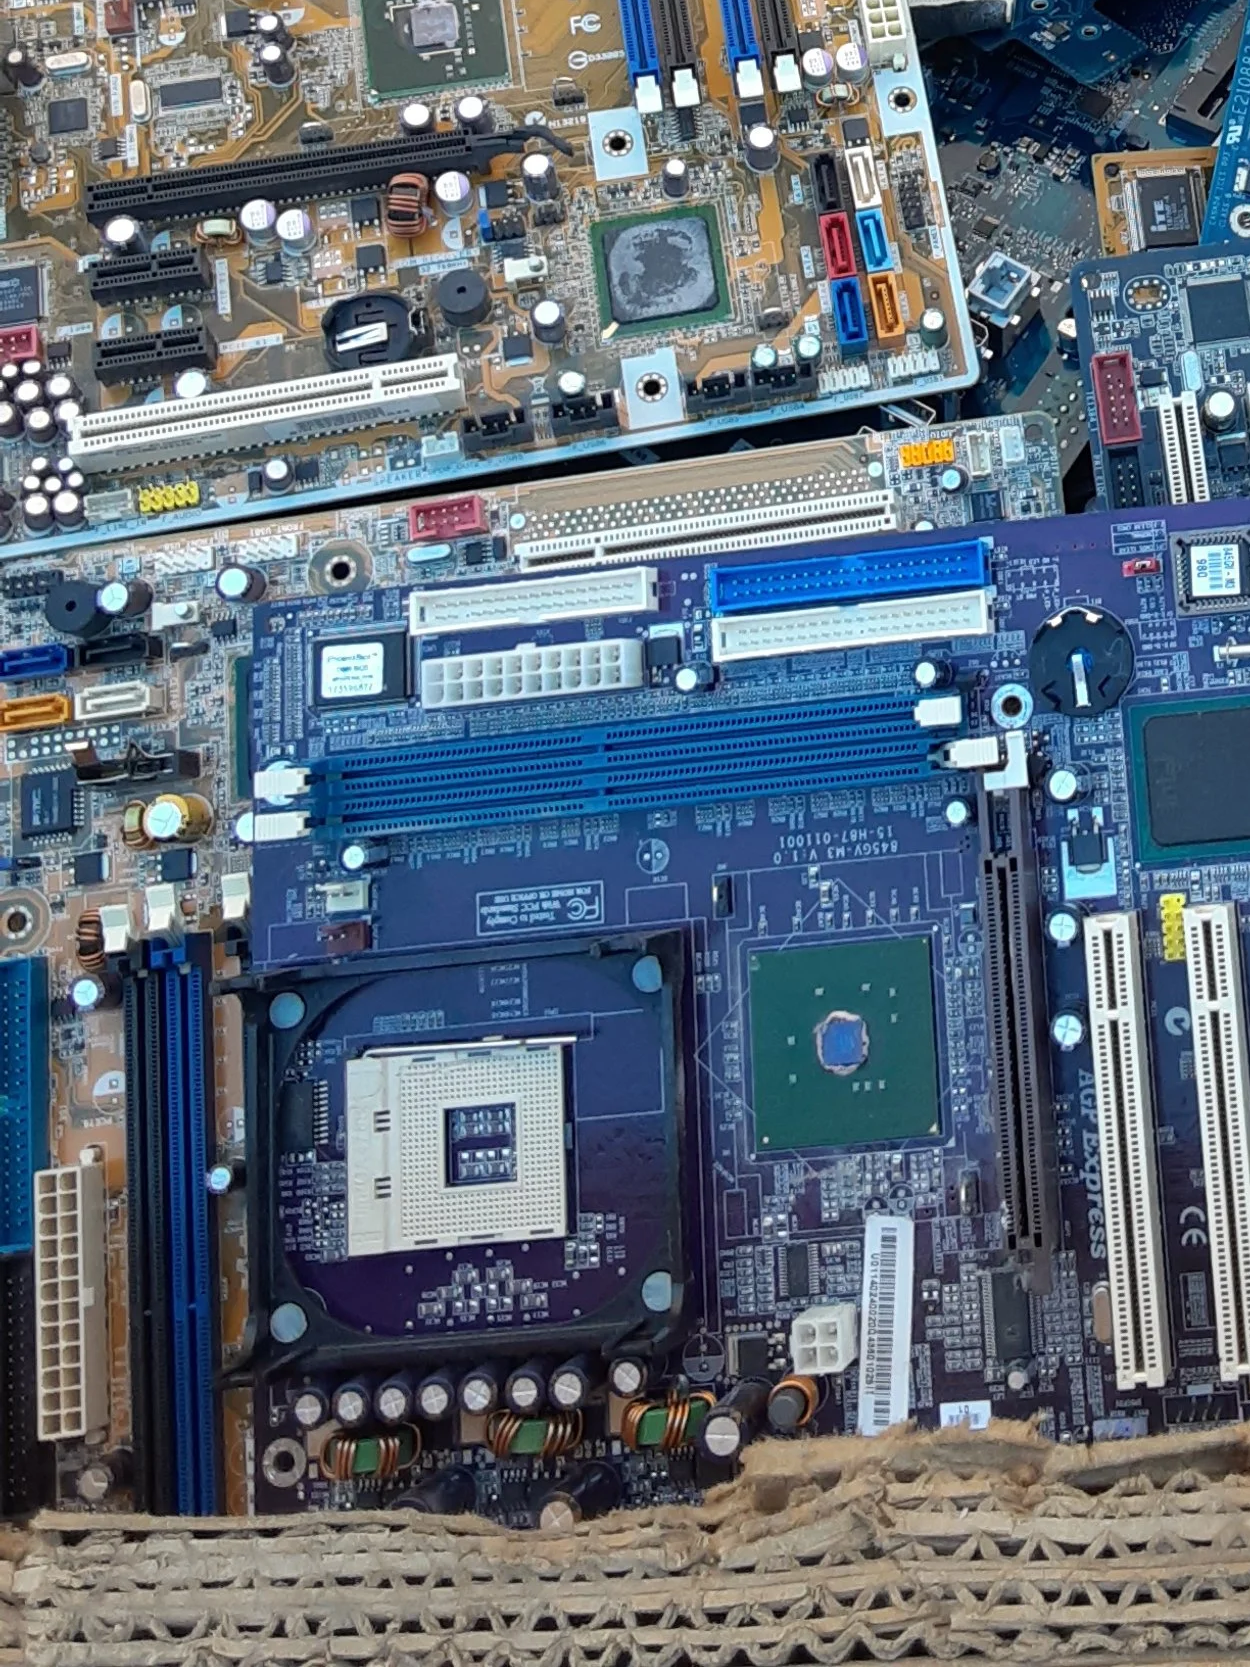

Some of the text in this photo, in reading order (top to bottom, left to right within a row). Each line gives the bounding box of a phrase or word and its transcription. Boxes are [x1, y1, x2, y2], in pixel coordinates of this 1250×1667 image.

[1150, 198, 1168, 233] iTE
[160, 508, 202, 522] F_AUDIO
[1196, 558, 1206, 578] 980
[778, 823, 893, 851] 15-H87-011001
[772, 838, 898, 864] 845GV-M3 V:1.0
[538, 890, 550, 898] OR
[575, 886, 591, 894] FOR
[479, 903, 519, 916] Standards
[521, 901, 539, 911] FCC
[484, 911, 555, 927] Tested to Comply
[1074, 1127, 1107, 1259] Express
[1179, 1206, 1205, 1245] CE
[958, 1405, 969, 1413] 01
